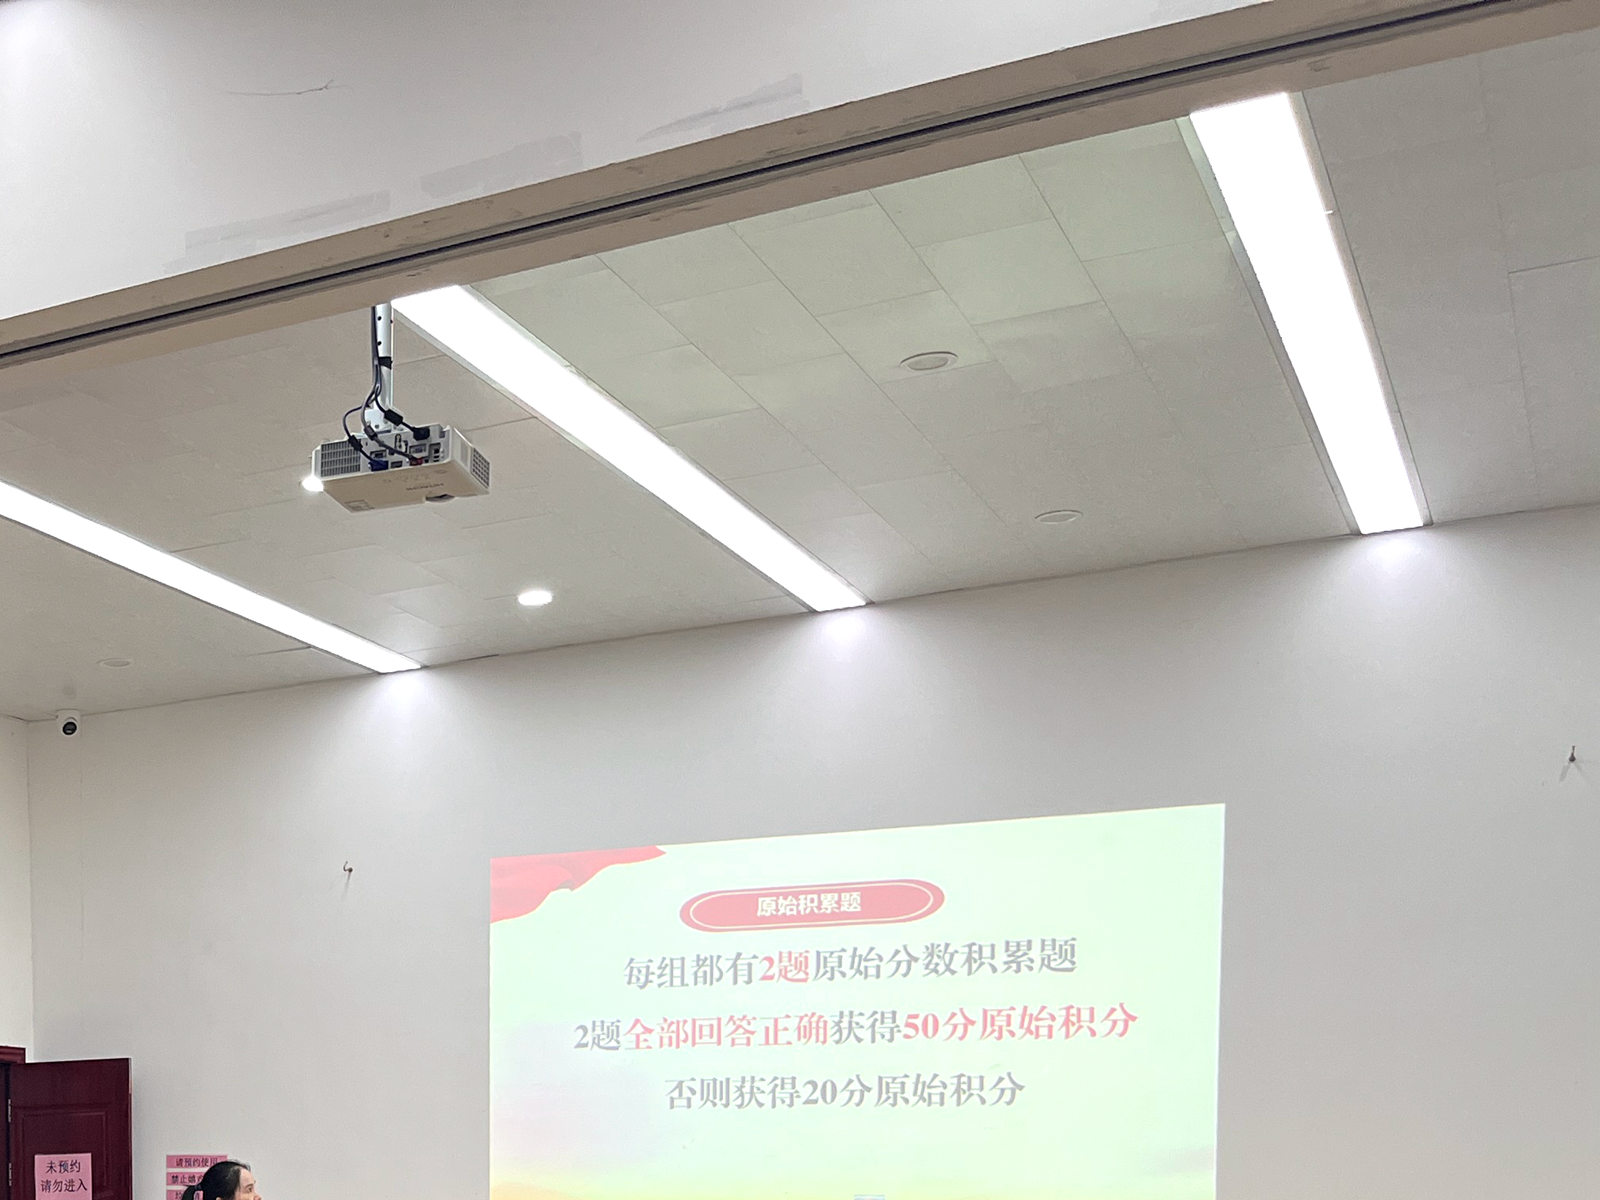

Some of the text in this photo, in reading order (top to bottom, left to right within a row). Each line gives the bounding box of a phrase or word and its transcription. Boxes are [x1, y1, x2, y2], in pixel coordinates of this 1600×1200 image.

[756, 891, 862, 918] 原始积累题
[623, 936, 1078, 990] 每组都有2题原始分数积累题
[573, 1001, 1139, 1051] 2题全部回答正确获得50分原始积分
[664, 1070, 1026, 1110] 否则获得20分原始积分
[45, 1159, 81, 1175] 未预约
[40, 1178, 88, 1194] 请勿进入
